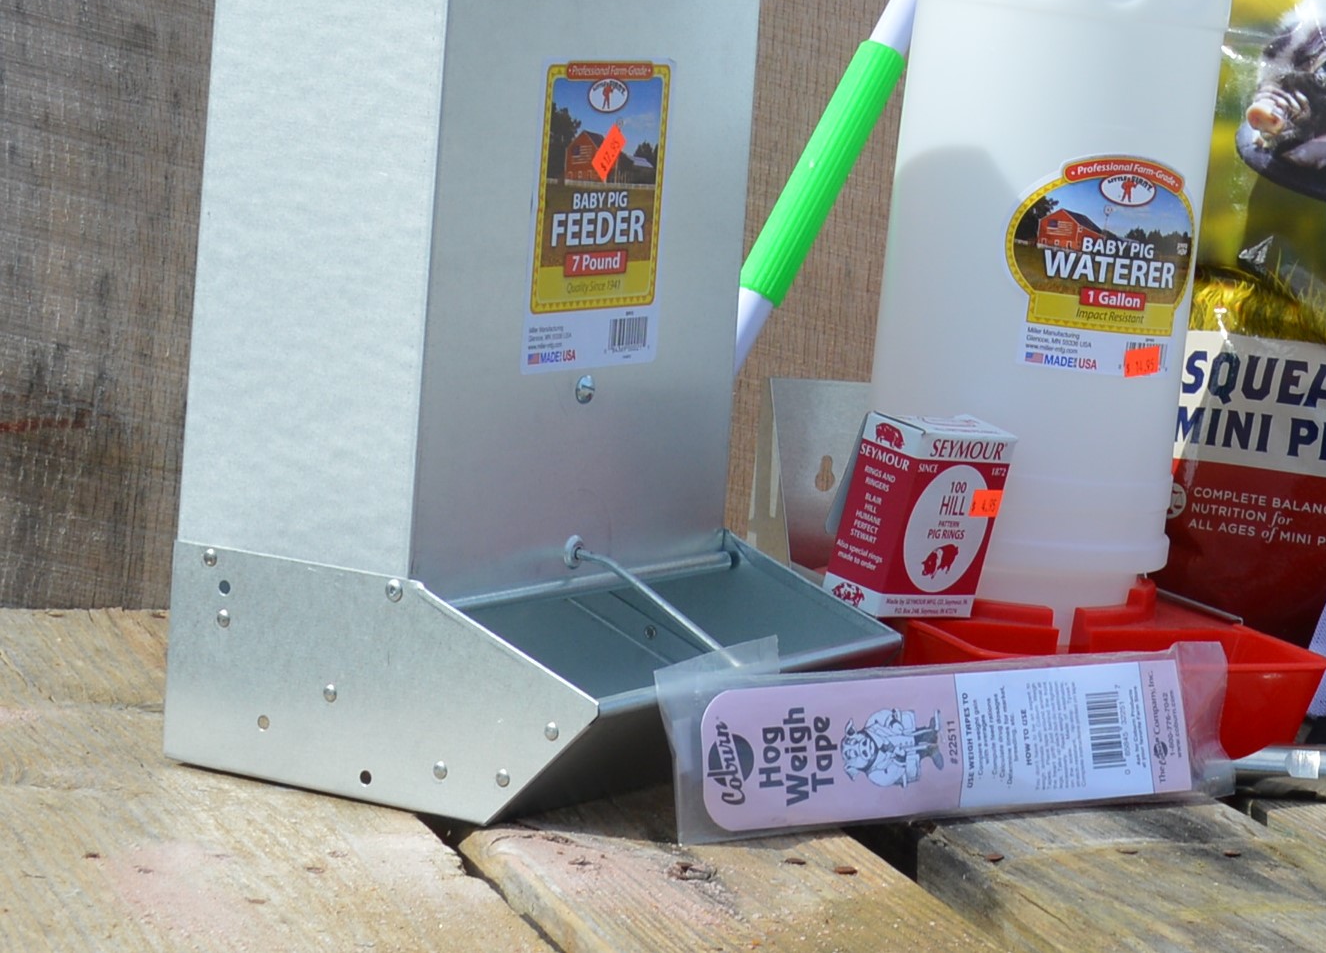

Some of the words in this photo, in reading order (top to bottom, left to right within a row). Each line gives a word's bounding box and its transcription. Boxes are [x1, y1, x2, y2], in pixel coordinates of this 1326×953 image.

[1077, 162, 1133, 175] Professional
[1133, 164, 1176, 186] Farm-Grade
[573, 192, 605, 210] BABY
[607, 190, 628, 207] PIG
[551, 209, 645, 247] FEEDER
[1082, 237, 1127, 256] BABY
[1129, 243, 1155, 259] PIG
[572, 255, 580, 272] 7
[582, 253, 621, 271] Pound
[1044, 249, 1175, 289] WATERER
[1087, 290, 1095, 304] 1
[1098, 291, 1141, 308] Gallon
[1076, 308, 1108, 321] Impact
[1108, 312, 1144, 324] Resistant
[562, 350, 576, 362] USA
[1078, 358, 1097, 370] USA
[1174, 405, 1273, 452] MINI
[860, 443, 910, 471] SEYMOUR
[930, 438, 1005, 461] SEYMOUR
[882, 472, 896, 483] AND
[917, 463, 939, 474] SINCE
[950, 481, 968, 494] 100
[1193, 486, 1268, 507] COMPLETE
[864, 492, 882, 506] BLAIR
[864, 503, 877, 514] HILL
[939, 495, 965, 516] HILL
[855, 509, 882, 526] HUMANE
[938, 520, 960, 528] PATTERN
[1191, 502, 1267, 523] NUTRITION
[1269, 511, 1294, 527] for
[850, 528, 877, 544] STEWART
[853, 519, 879, 535] PERFECT
[927, 528, 941, 539] PIG
[941, 529, 965, 540] RINGS
[1188, 518, 1213, 531] ALL
[1217, 523, 1256, 538] AGES
[1260, 526, 1279, 544] of
[1279, 531, 1312, 546] MINI
[853, 557, 860, 565] to
[961, 692, 969, 705] TO
[963, 707, 973, 736] TAPES
[1020, 709, 1028, 726] USE
[946, 719, 959, 765] #22511
[1023, 728, 1029, 740] TO
[707, 720, 746, 806] Coburn
[758, 726, 785, 789] Hog
[783, 706, 812, 807] Weigh
[811, 716, 838, 793] Tape
[966, 737, 975, 770] WEIGH
[966, 771, 975, 789] USE
